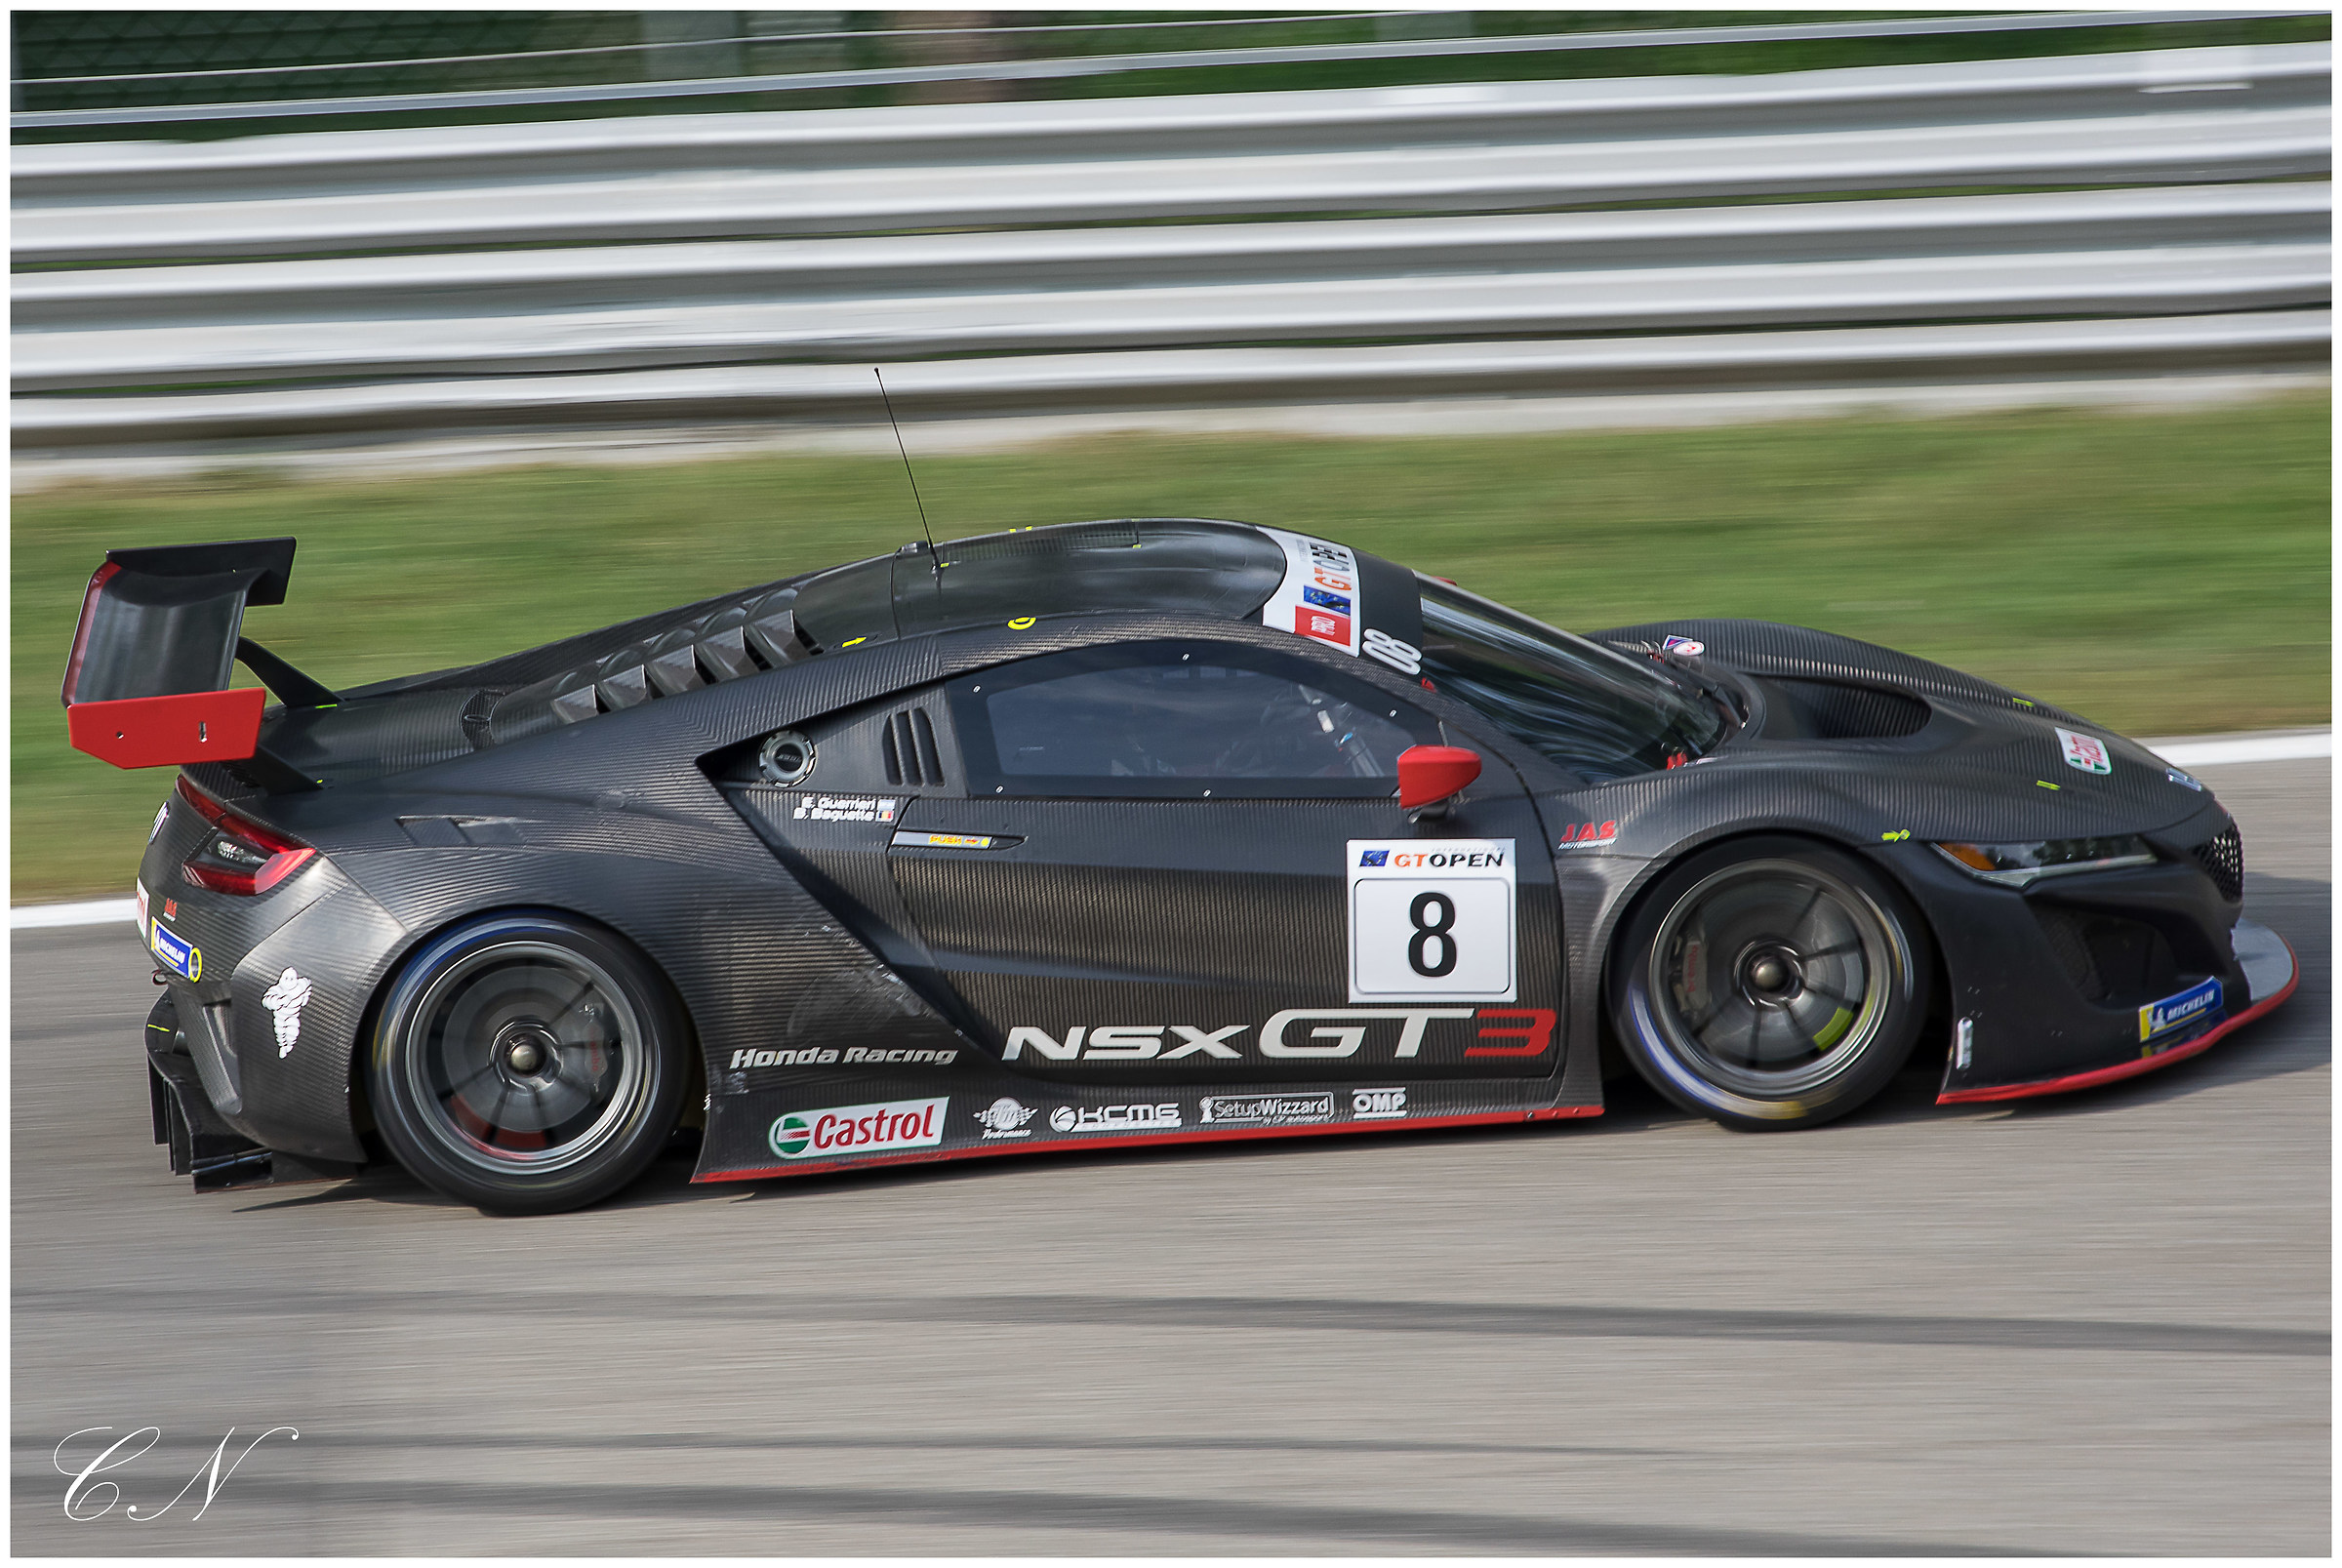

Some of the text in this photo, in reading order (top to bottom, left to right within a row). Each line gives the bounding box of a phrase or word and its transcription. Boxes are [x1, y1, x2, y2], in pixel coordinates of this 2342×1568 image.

[1362, 628, 1423, 675] 08
[1560, 820, 1617, 842] JAS
[1408, 892, 1458, 978] 8
[2167, 988, 2215, 1021] MICHELIN
[1002, 1008, 1557, 1061] NSX GT3
[730, 1047, 959, 1069] Honda Racing
[1214, 1097, 1329, 1118] SetupWizzard
[1353, 1092, 1407, 1112] OMP
[814, 1104, 936, 1149] Castrol
